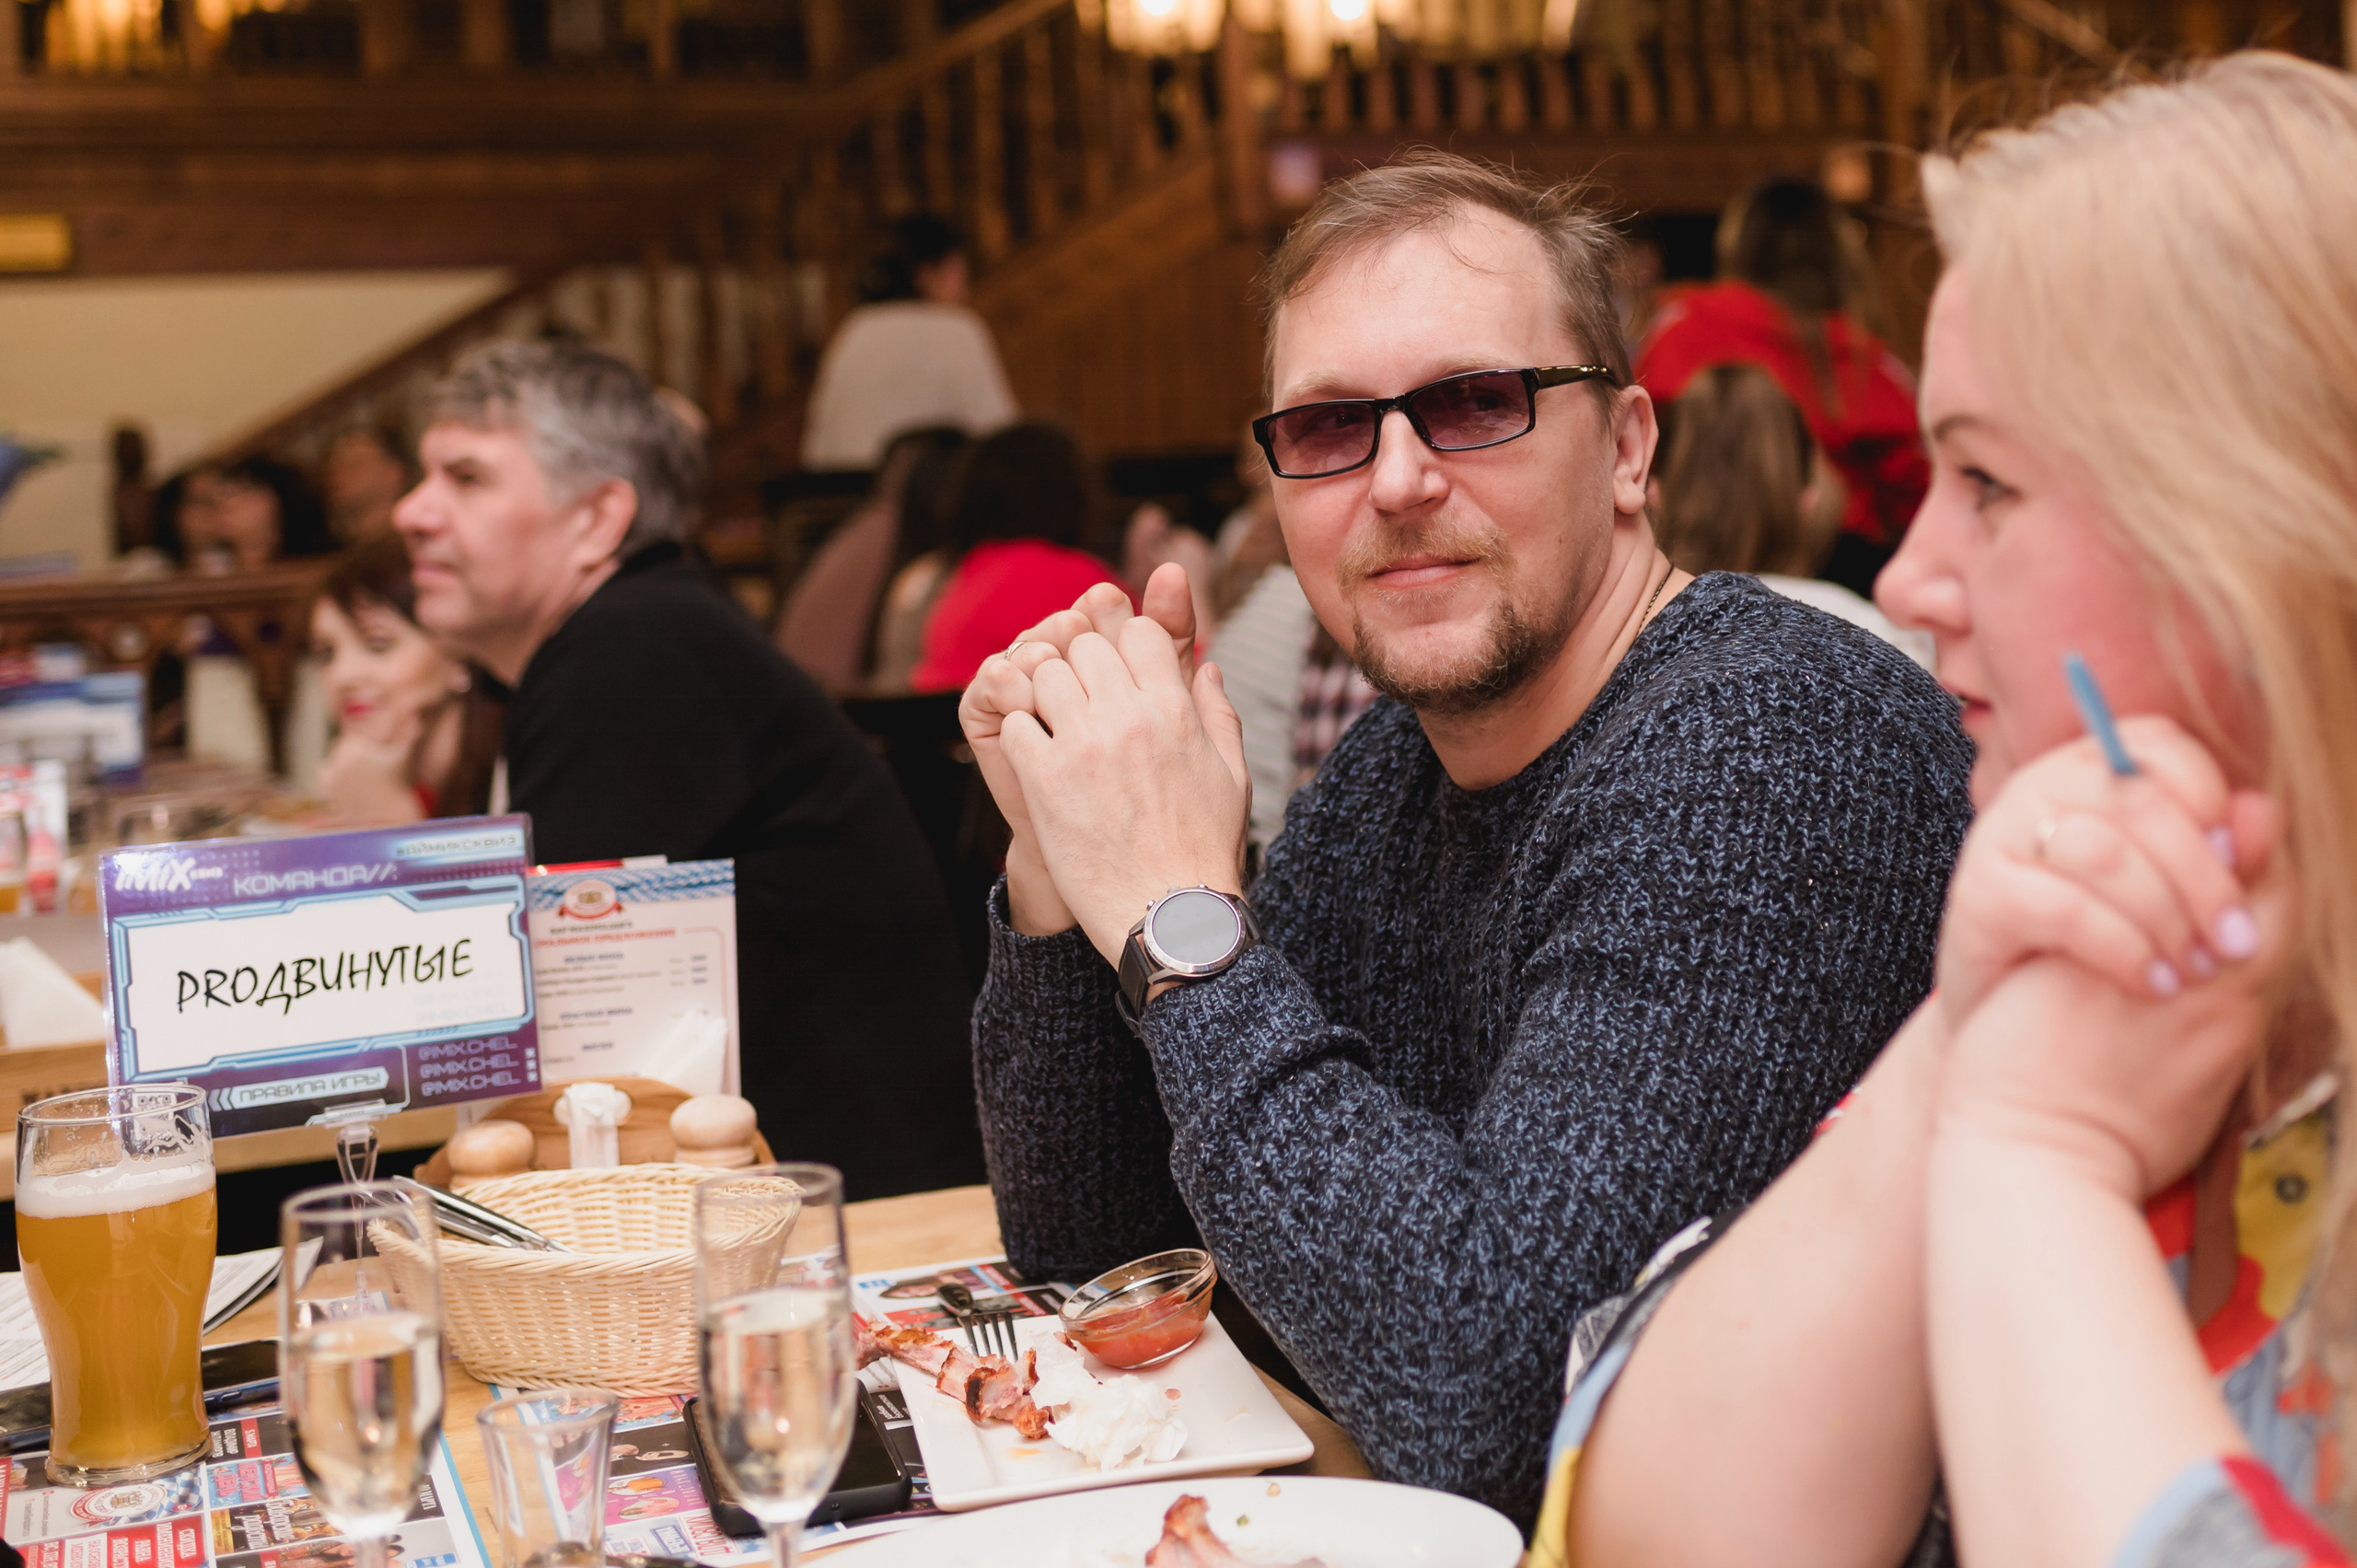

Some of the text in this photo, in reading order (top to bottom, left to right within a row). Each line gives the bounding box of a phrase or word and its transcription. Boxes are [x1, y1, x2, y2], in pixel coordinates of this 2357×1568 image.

[239, 1073, 381, 1103] ПРАВИЛА ИГРЫ
[212, 1473, 238, 1497] ДЕНЬ
[135, 1539, 152, 1563] РАВНА
[177, 1528, 196, 1559] СКИДКА
